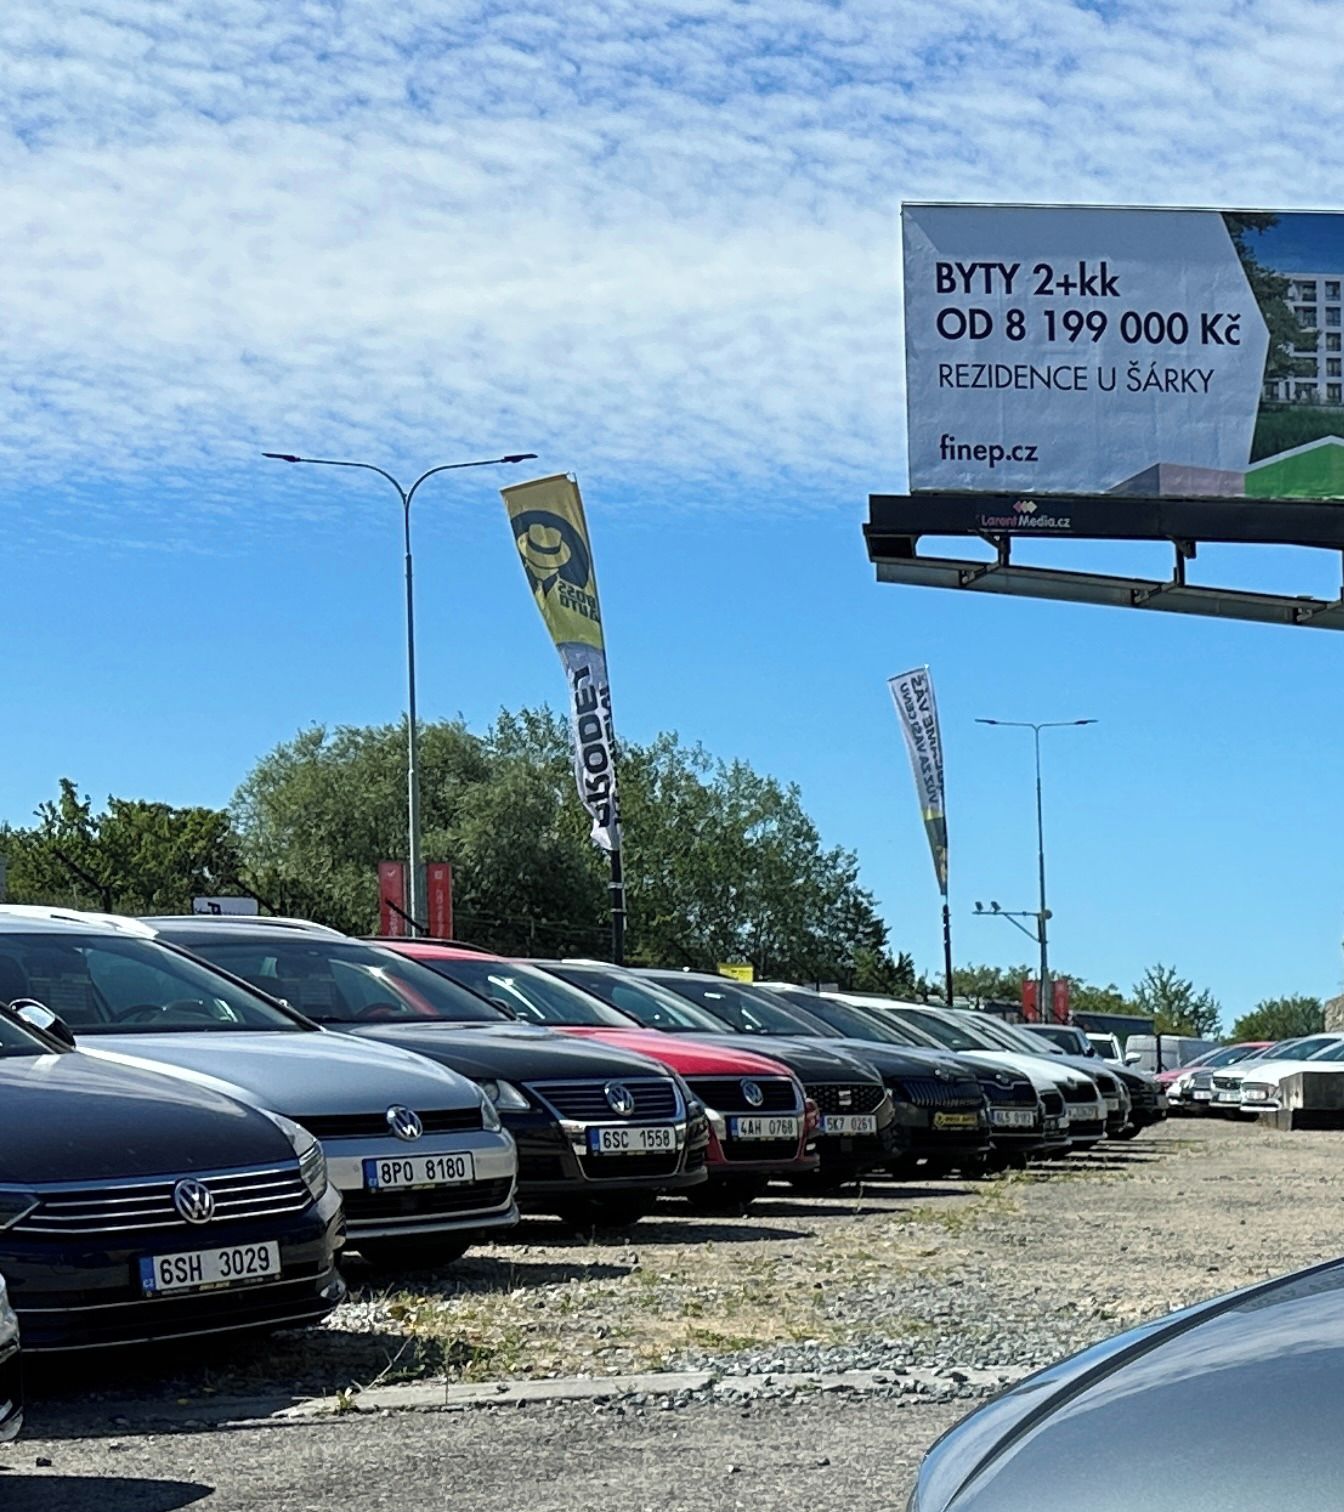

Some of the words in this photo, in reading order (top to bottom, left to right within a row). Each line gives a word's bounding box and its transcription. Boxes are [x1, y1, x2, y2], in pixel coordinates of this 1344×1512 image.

[936, 262, 1020, 294] BYTY
[1032, 261, 1121, 297] 2+kk
[936, 307, 993, 340] OD
[1005, 309, 1026, 341] 8
[1043, 310, 1107, 343] 199
[1120, 311, 1188, 345] 000
[1201, 313, 1241, 346] Kč
[939, 364, 1088, 391] REZIDENCE
[1097, 367, 1116, 392] U
[1127, 360, 1214, 393] ŠÁRKY
[940, 433, 1038, 468] finep.cz
[603, 1131, 629, 1149] 6SC
[640, 1129, 670, 1147] 1558
[425, 1157, 465, 1180] 8180
[160, 1254, 203, 1285] 6SH
[218, 1246, 270, 1277] 3029
